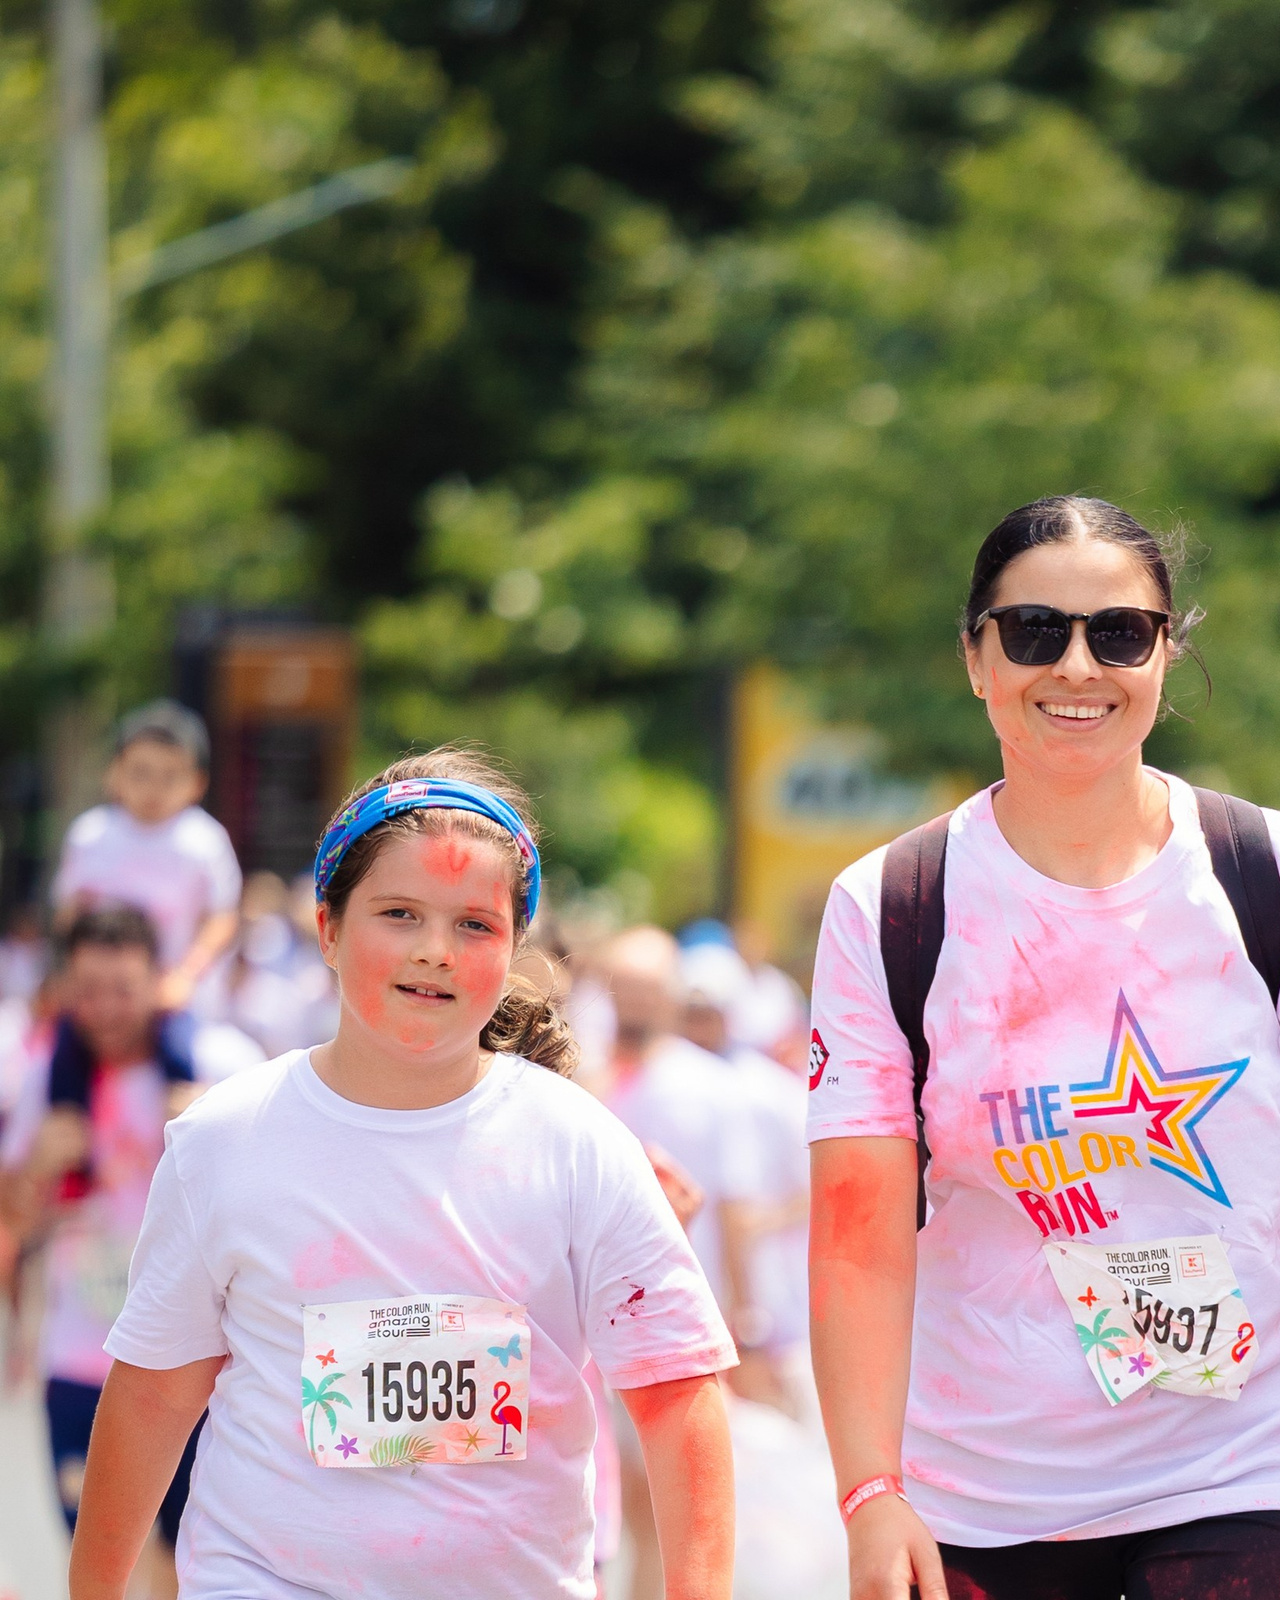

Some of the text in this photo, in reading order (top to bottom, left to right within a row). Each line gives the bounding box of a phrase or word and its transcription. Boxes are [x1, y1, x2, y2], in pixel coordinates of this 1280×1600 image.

[827, 1076, 839, 1086] FM
[979, 1085, 1069, 1147] THE
[992, 1132, 1143, 1193] COLOR
[1105, 1253, 1121, 1263] THE
[1122, 1250, 1150, 1263] COLOR
[1107, 1262, 1170, 1275] amazing
[370, 1308, 386, 1320] THE
[386, 1305, 413, 1317] COLOR
[369, 1315, 430, 1329] amazing
[1122, 1288, 1219, 1356] 5937
[377, 1329, 405, 1338] tour
[361, 1360, 477, 1423] 15935
